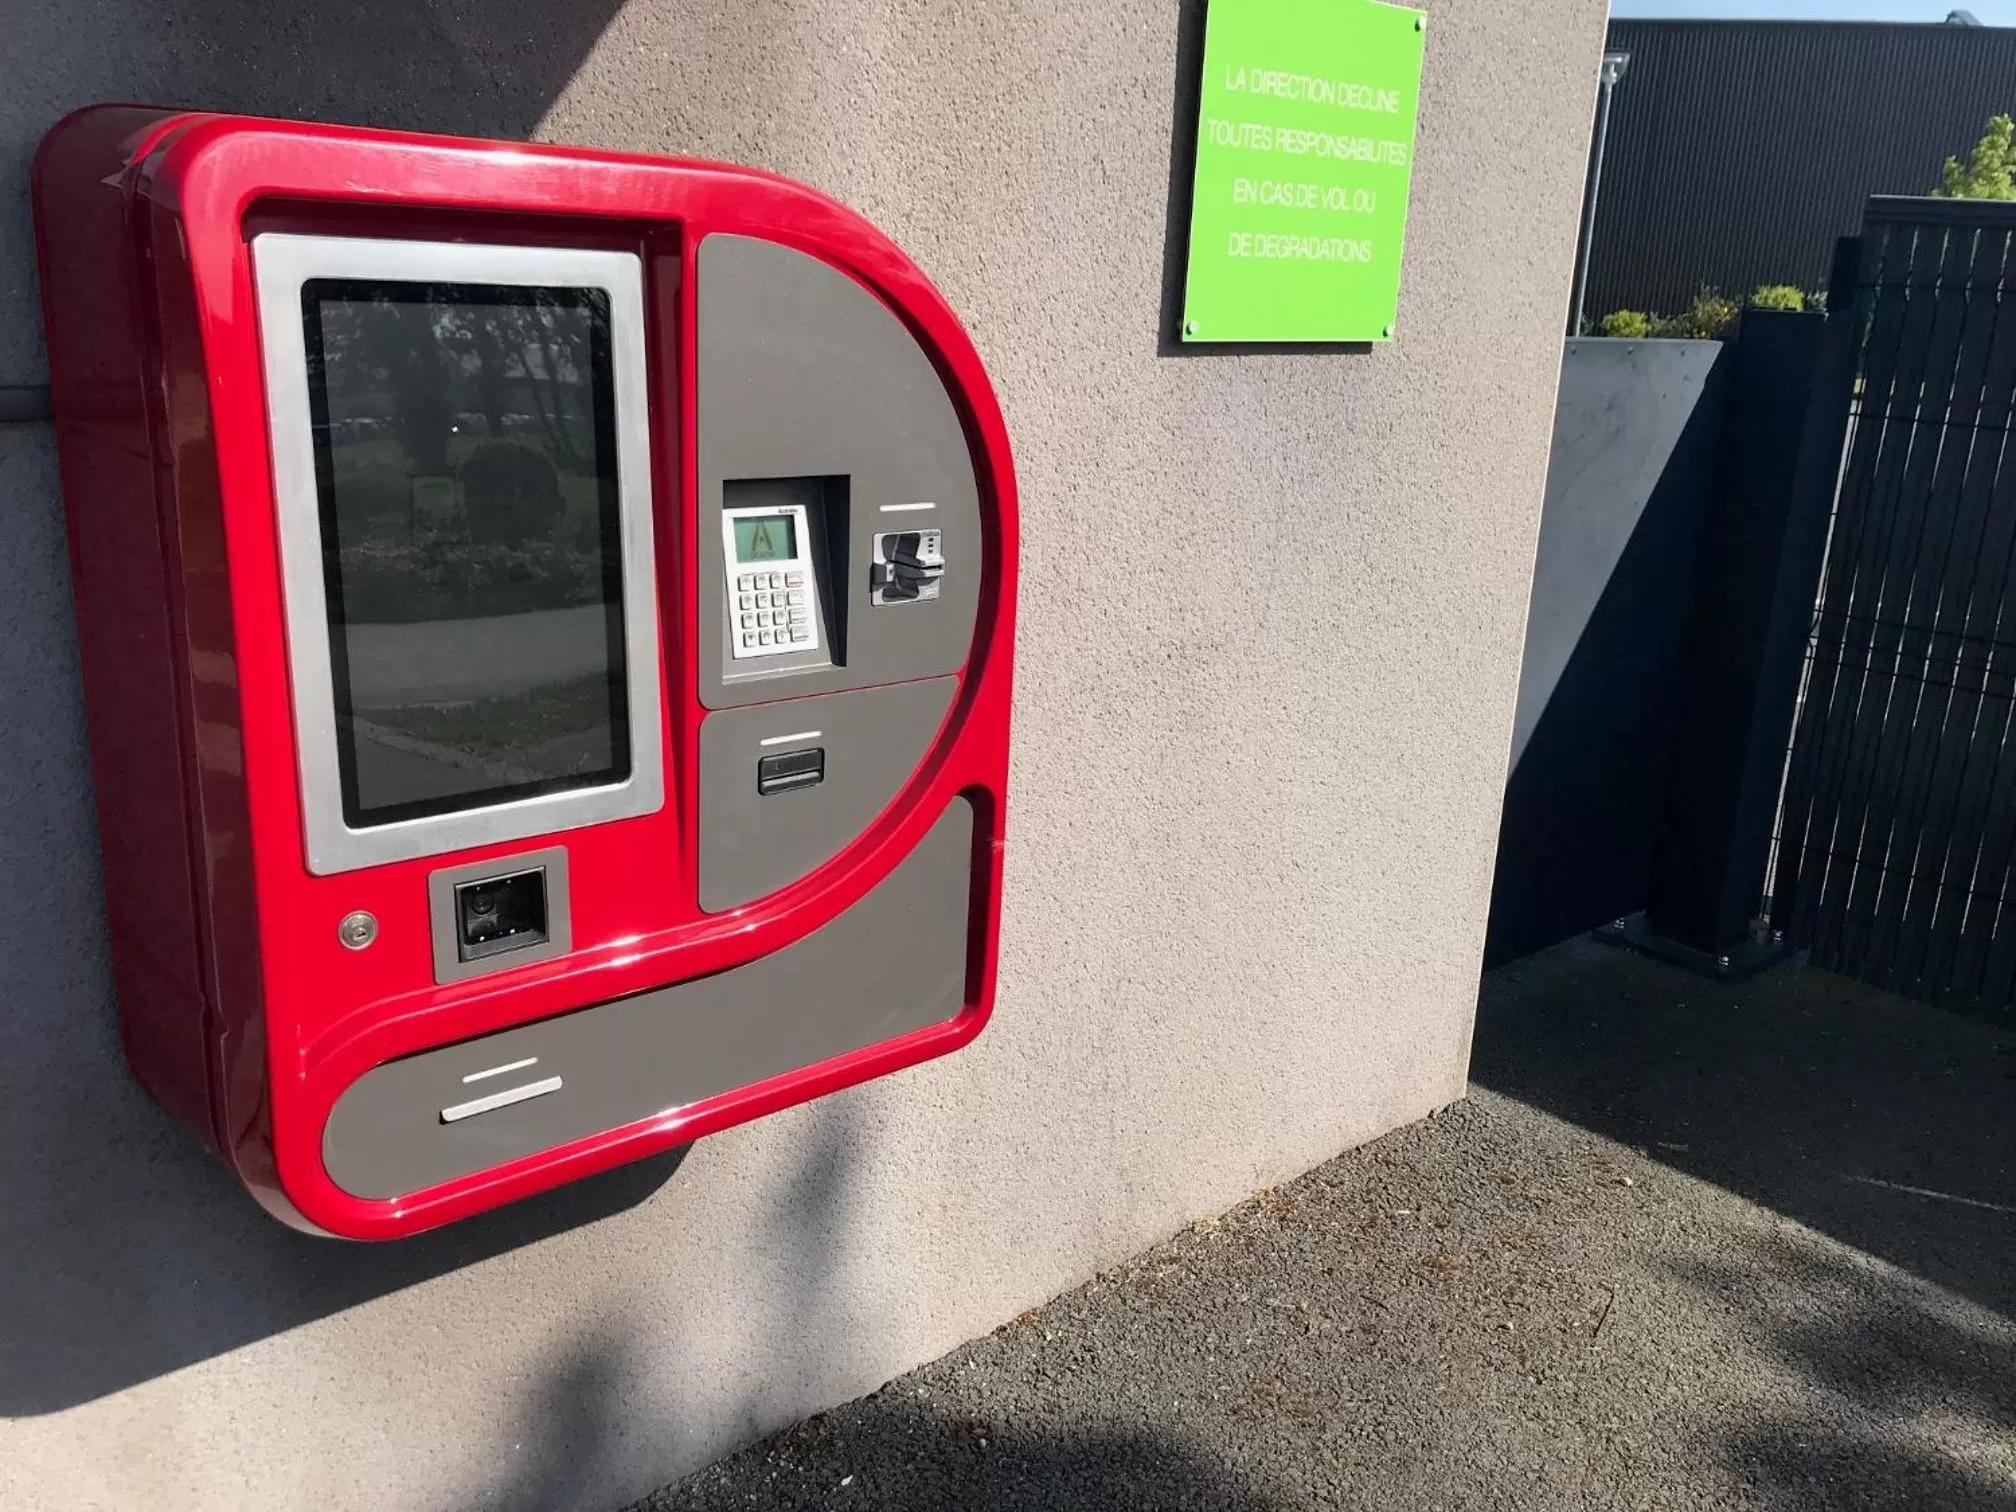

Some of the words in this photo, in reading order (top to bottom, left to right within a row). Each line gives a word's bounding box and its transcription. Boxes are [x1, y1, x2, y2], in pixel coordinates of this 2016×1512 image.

[1225, 65, 1247, 91] LA
[1250, 68, 1335, 104] DIRECTION
[1338, 82, 1401, 113] DECLINE
[1208, 119, 1272, 150] TOUTES
[1276, 128, 1407, 166] RESPONSABILITES
[1233, 177, 1257, 203] EN
[1260, 180, 1293, 206] CAS
[1296, 184, 1319, 209] DE
[1321, 187, 1350, 211] VOL
[1354, 189, 1376, 213] OU
[1228, 232, 1252, 257] DE
[1255, 234, 1373, 263] DEGRADATIONS
